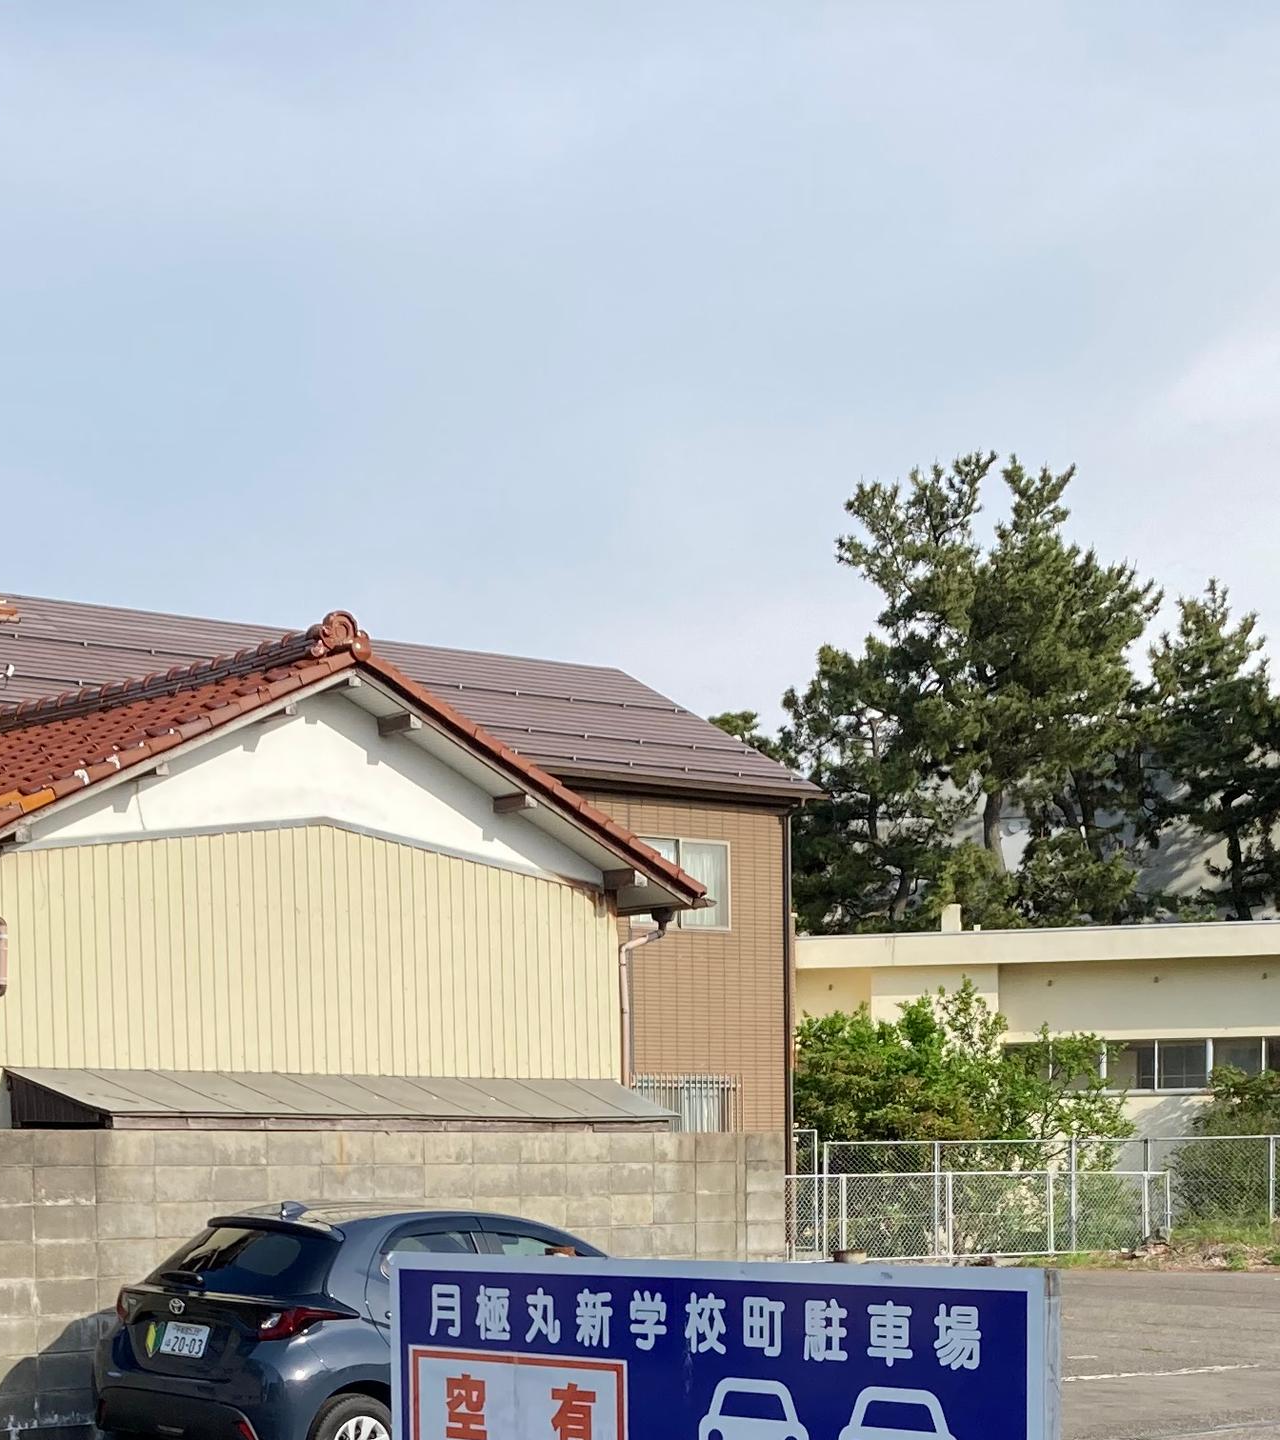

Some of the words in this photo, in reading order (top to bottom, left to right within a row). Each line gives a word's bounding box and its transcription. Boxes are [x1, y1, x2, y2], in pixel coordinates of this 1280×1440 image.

[429, 1284, 982, 1370] 月極丸新学校町駐車場
